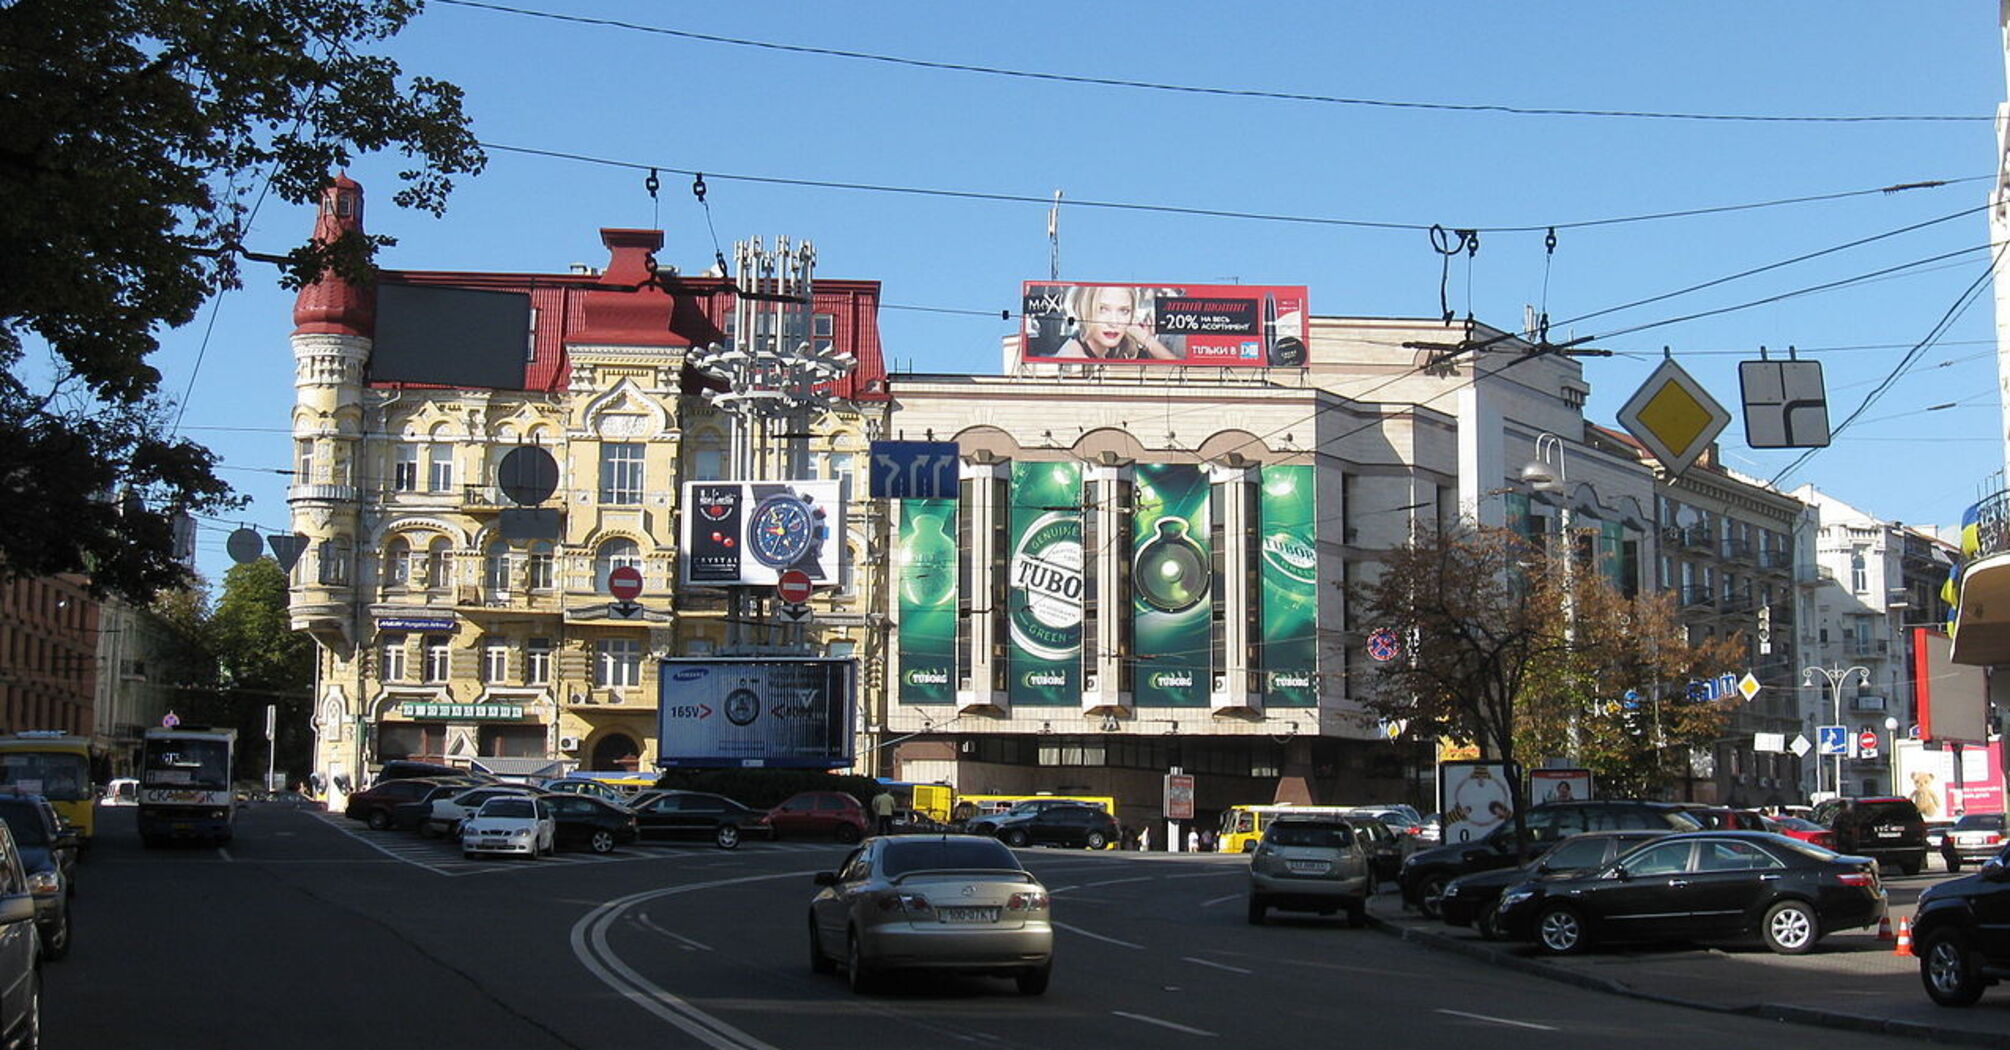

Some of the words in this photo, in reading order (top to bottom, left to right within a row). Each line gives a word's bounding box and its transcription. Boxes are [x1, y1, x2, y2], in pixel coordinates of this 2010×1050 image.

[1160, 314, 1199, 330] -20%
[1200, 322, 1251, 331] АСОРТИМЕНТ
[1191, 346, 1228, 355] ТІЛЬКИ
[1230, 346, 1237, 355] В
[1018, 559, 1082, 601] TUBO
[1028, 624, 1067, 643] GREEN
[912, 672, 948, 684] TUBORG
[1030, 674, 1066, 685] TUBORG
[1157, 676, 1193, 687] TUBORG
[1274, 676, 1309, 687] TUBORG
[671, 705, 699, 718] 165V
